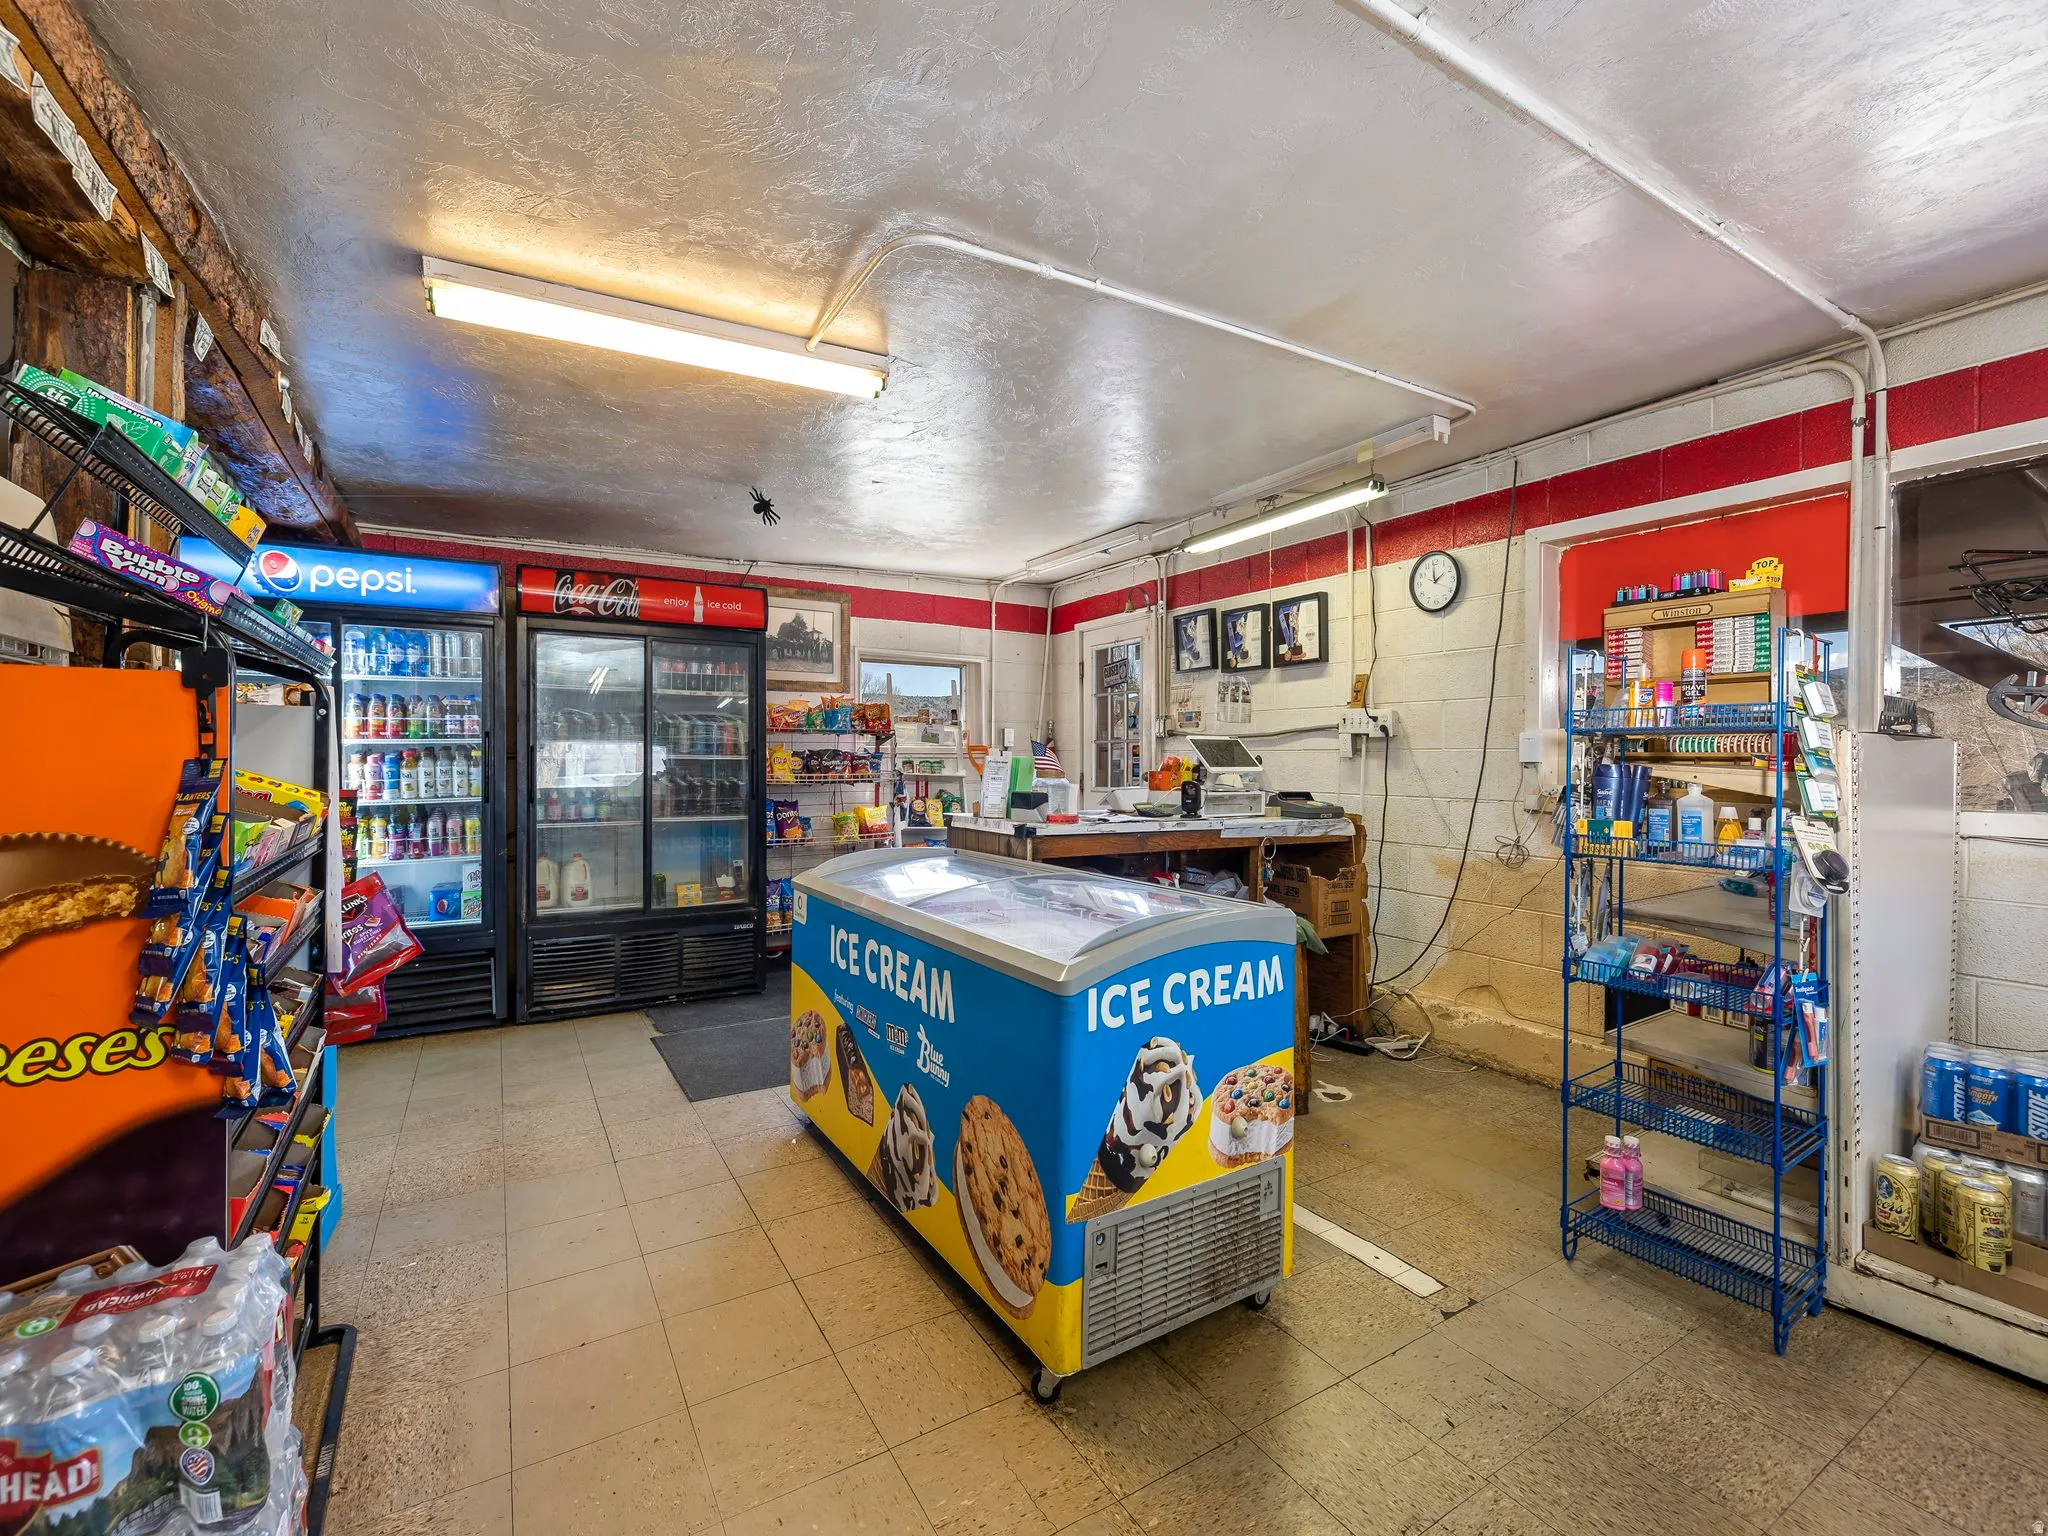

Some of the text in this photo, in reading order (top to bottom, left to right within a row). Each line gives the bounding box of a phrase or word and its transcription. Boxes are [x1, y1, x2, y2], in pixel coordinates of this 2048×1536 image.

[100, 538, 200, 584] Bubble
[106, 552, 167, 587] Yum
[1756, 560, 1775, 569] TOP
[186, 589, 223, 615] Origina
[553, 574, 641, 619] Coca-Cola
[663, 597, 742, 611] enjoy ice cold
[1662, 607, 1702, 618] Winston
[1597, 788, 1614, 798] Suave
[829, 924, 955, 1023] ICE CREAM
[834, 989, 855, 1015] featuring
[1087, 955, 1285, 1033] ICE CREAM
[182, 1405, 208, 1416] WATER
